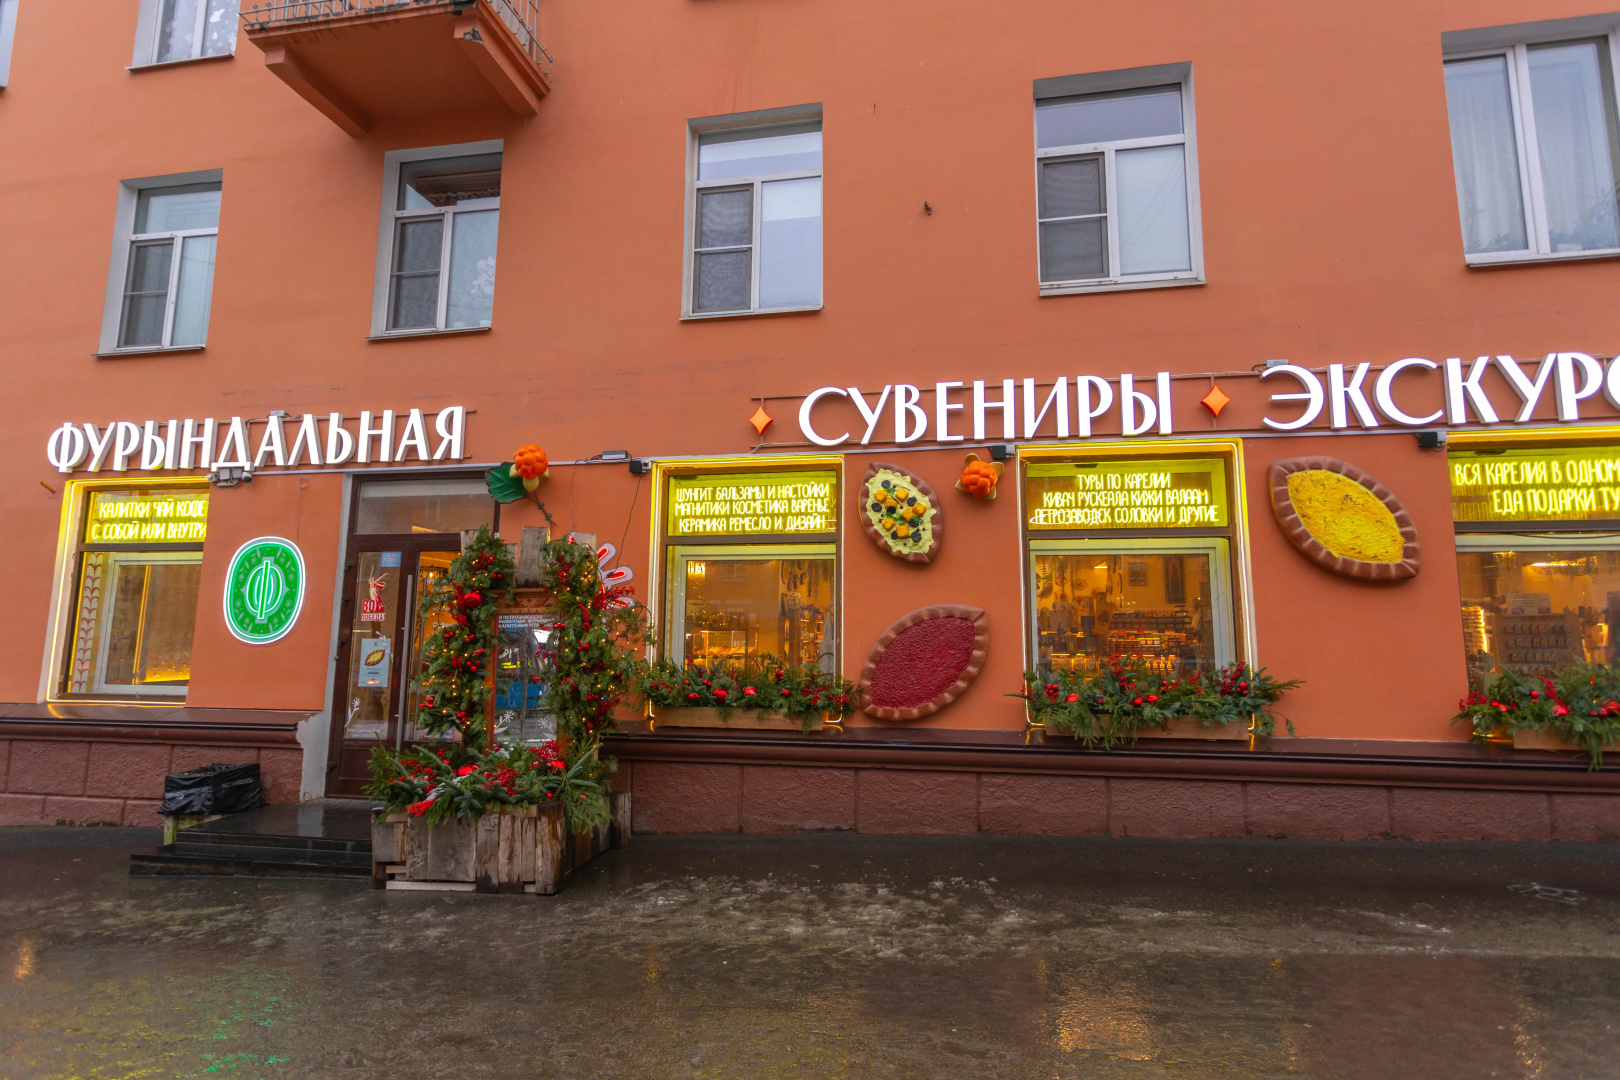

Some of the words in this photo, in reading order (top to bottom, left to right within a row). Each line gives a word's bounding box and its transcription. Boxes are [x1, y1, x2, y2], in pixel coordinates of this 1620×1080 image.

[798, 372, 1172, 445] СУВЕНИРЫ
[1259, 352, 1620, 430] ЭКСКУР
[47, 405, 467, 473] ФУРЫНДАЛЬНАЯ
[1077, 474, 1103, 490] ТУРЫ
[1106, 473, 1121, 489] ПО
[1124, 472, 1171, 488] КАРЕЛИИ
[1454, 463, 1482, 486] ВСЯ
[1485, 461, 1548, 484] КАРЕЛИЯ
[1551, 460, 1562, 484] В
[1566, 458, 1620, 486] ОДНОМ
[676, 487, 712, 502] ШУНГИТ
[716, 485, 765, 500] БАЛЬЗАМЫ
[767, 484, 776, 499] И
[778, 482, 829, 499] НАСТОЙКИ
[1043, 491, 1075, 508] КИВАЧ
[1077, 490, 1129, 507] РУСКЕАЛА
[1131, 489, 1163, 506] КИЖИ
[1165, 488, 1209, 506] ВАЛААМ
[1493, 489, 1524, 515] ЕДА
[1526, 488, 1597, 515] ПОДАРКИ
[99, 501, 151, 518] КАЛИТКИ
[153, 498, 175, 517] ЧАЙ
[175, 500, 206, 518] КОФЕ
[675, 501, 730, 516] МАГНИТИКИ
[732, 499, 788, 515] КОСМЕТИКА
[791, 498, 830, 513] ВАРЕНЬЕ
[1035, 507, 1112, 526] ПЕТРОЗАВОДСК
[1114, 507, 1164, 523] СОЛОВКИ
[1166, 506, 1175, 522] И
[1179, 505, 1219, 523] ДРУГИЕ
[91, 523, 100, 540] С
[102, 520, 139, 540] СОБОЙ
[140, 522, 166, 539] ИЛИ
[166, 522, 207, 539] ВНУТРИ
[679, 517, 726, 533] КЕРАМИКА
[729, 516, 772, 532] РЕМЕСЛО
[774, 515, 782, 530] И
[785, 513, 826, 532] ДИЗАЙН
[361, 599, 375, 613] 80
